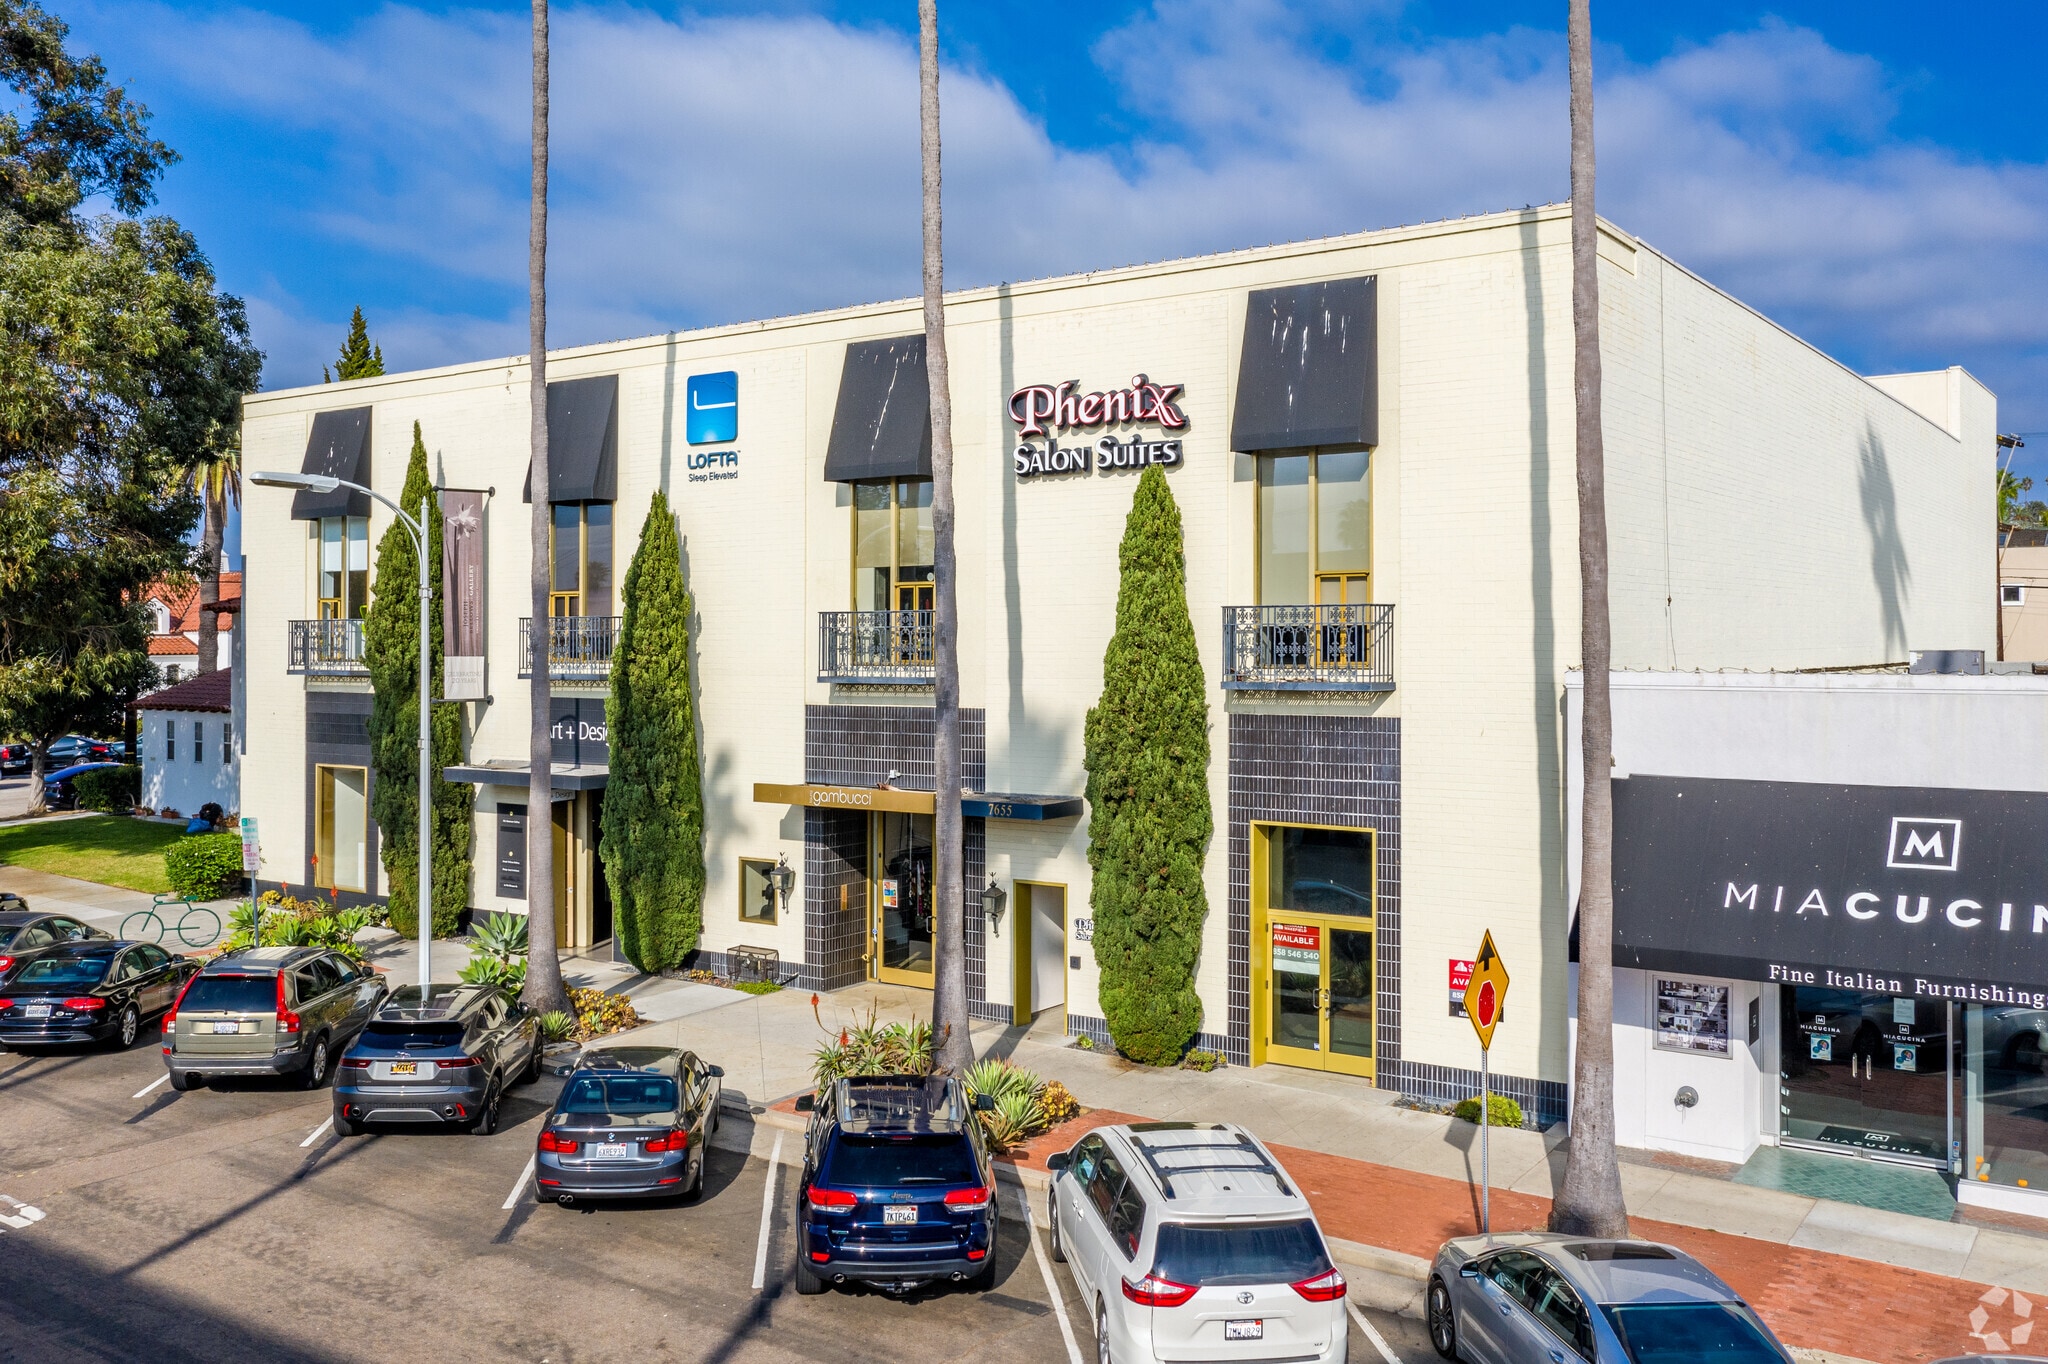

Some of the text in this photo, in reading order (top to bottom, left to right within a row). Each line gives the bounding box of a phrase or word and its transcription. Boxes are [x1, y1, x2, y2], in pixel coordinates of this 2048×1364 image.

[1006, 374, 1186, 437] Phenix
[687, 450, 739, 470] LOFTA
[688, 470, 738, 483] Sleep Elevated
[813, 789, 872, 806] gambucci
[988, 803, 1012, 817] 7655
[1273, 934, 1314, 945] AVAILABLE
[1287, 949, 1302, 958] 546
[1769, 964, 2048, 1009] Fine Italian Furnishing
[1800, 1024, 1841, 1033] MIACUCINA
[1883, 1033, 1926, 1043] MIACUCINA
[1820, 1137, 1921, 1154] MIACUCINA
[885, 1212, 915, 1221] 7KTP461
